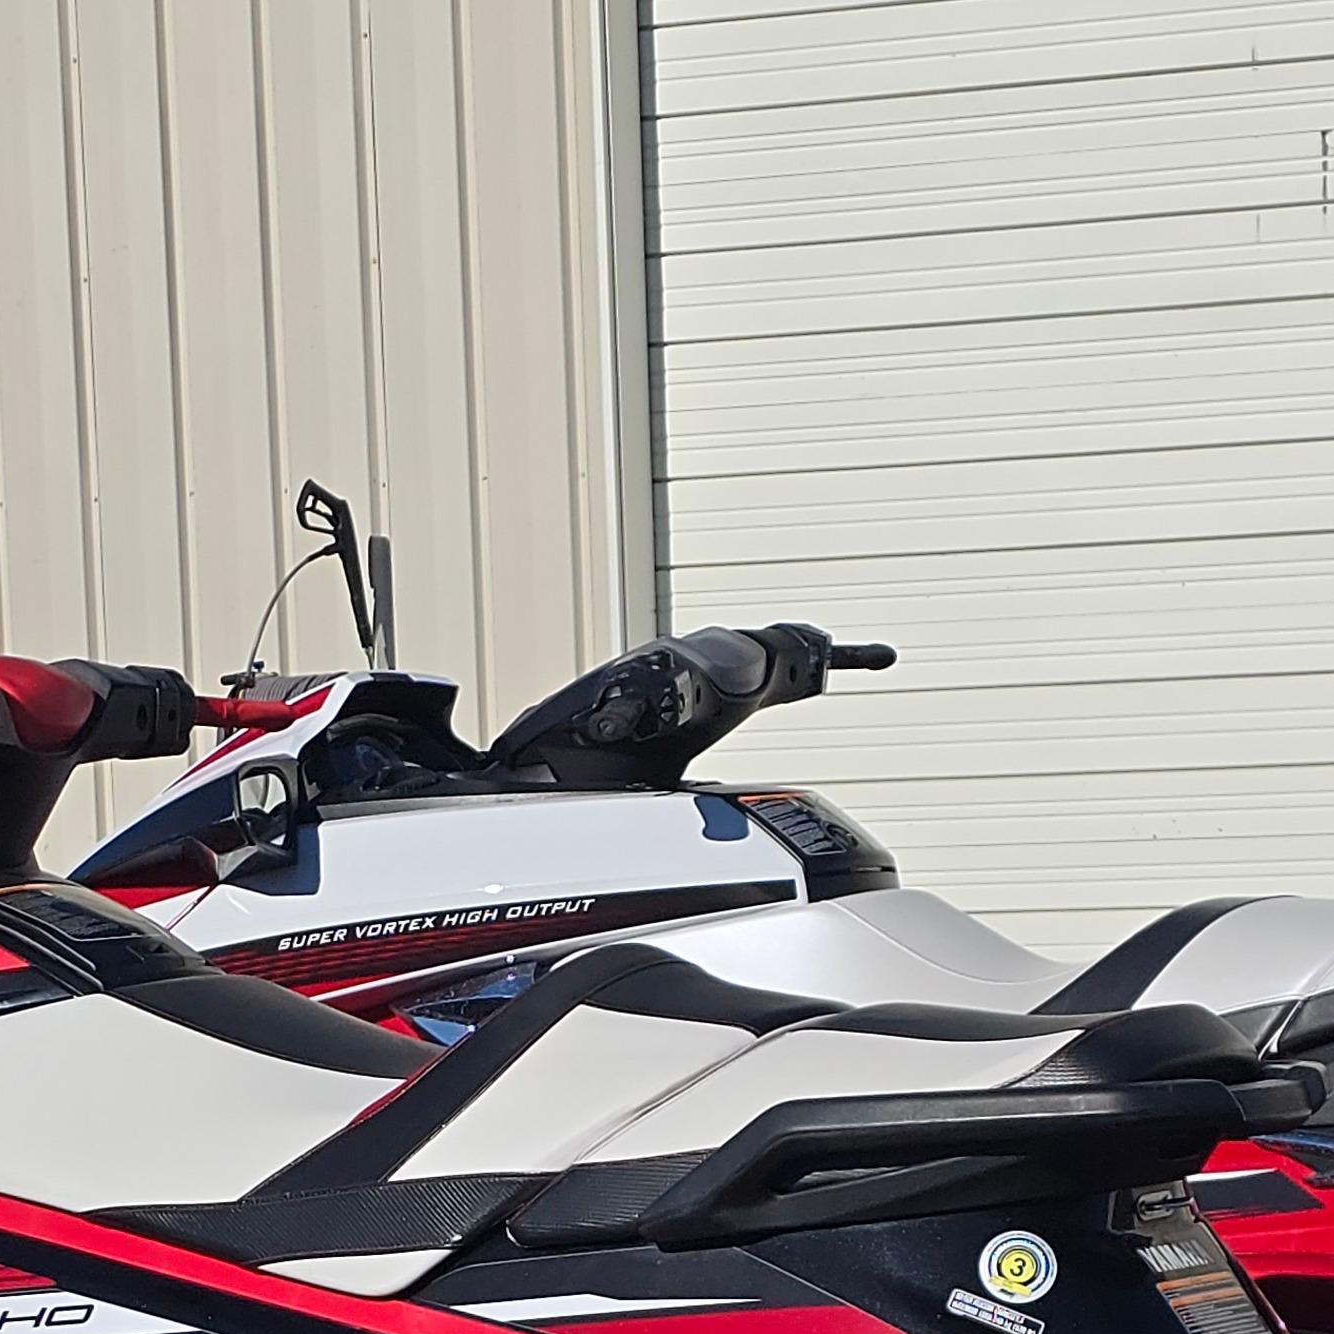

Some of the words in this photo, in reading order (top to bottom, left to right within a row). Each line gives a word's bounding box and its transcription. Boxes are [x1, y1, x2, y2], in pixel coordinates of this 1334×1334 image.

[278, 928, 347, 951] SUPER
[355, 915, 437, 940] VORTEX
[442, 908, 499, 928] HIGH
[505, 898, 595, 920] OUTPUT
[1009, 1257, 1027, 1277] 3
